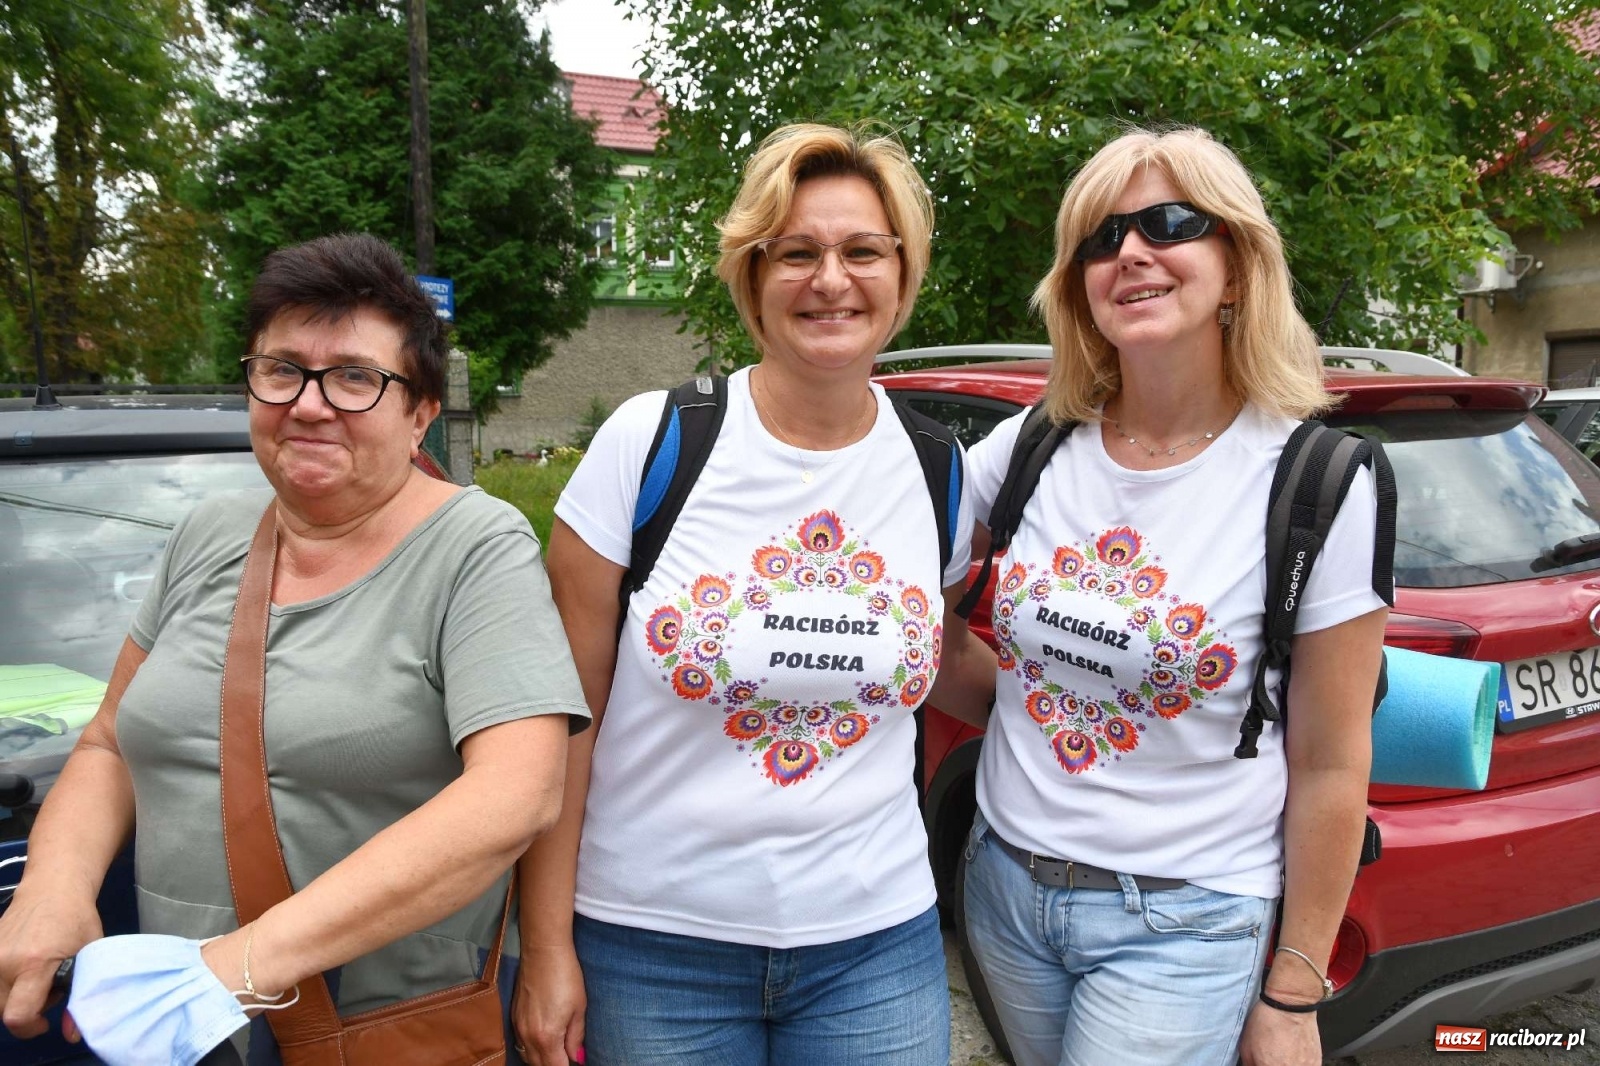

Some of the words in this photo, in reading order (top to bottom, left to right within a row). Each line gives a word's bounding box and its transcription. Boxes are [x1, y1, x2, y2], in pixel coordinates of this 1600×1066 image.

[1285, 551, 1306, 612] Quechua
[763, 614, 880, 636] RACIBÓRZ
[1036, 606, 1131, 651] RACIBÓRZ
[769, 651, 865, 672] POLSKA
[1042, 644, 1114, 678] POLSKA
[1515, 659, 1562, 711] SR
[1569, 648, 1600, 699] 86
[1498, 700, 1511, 714] PL
